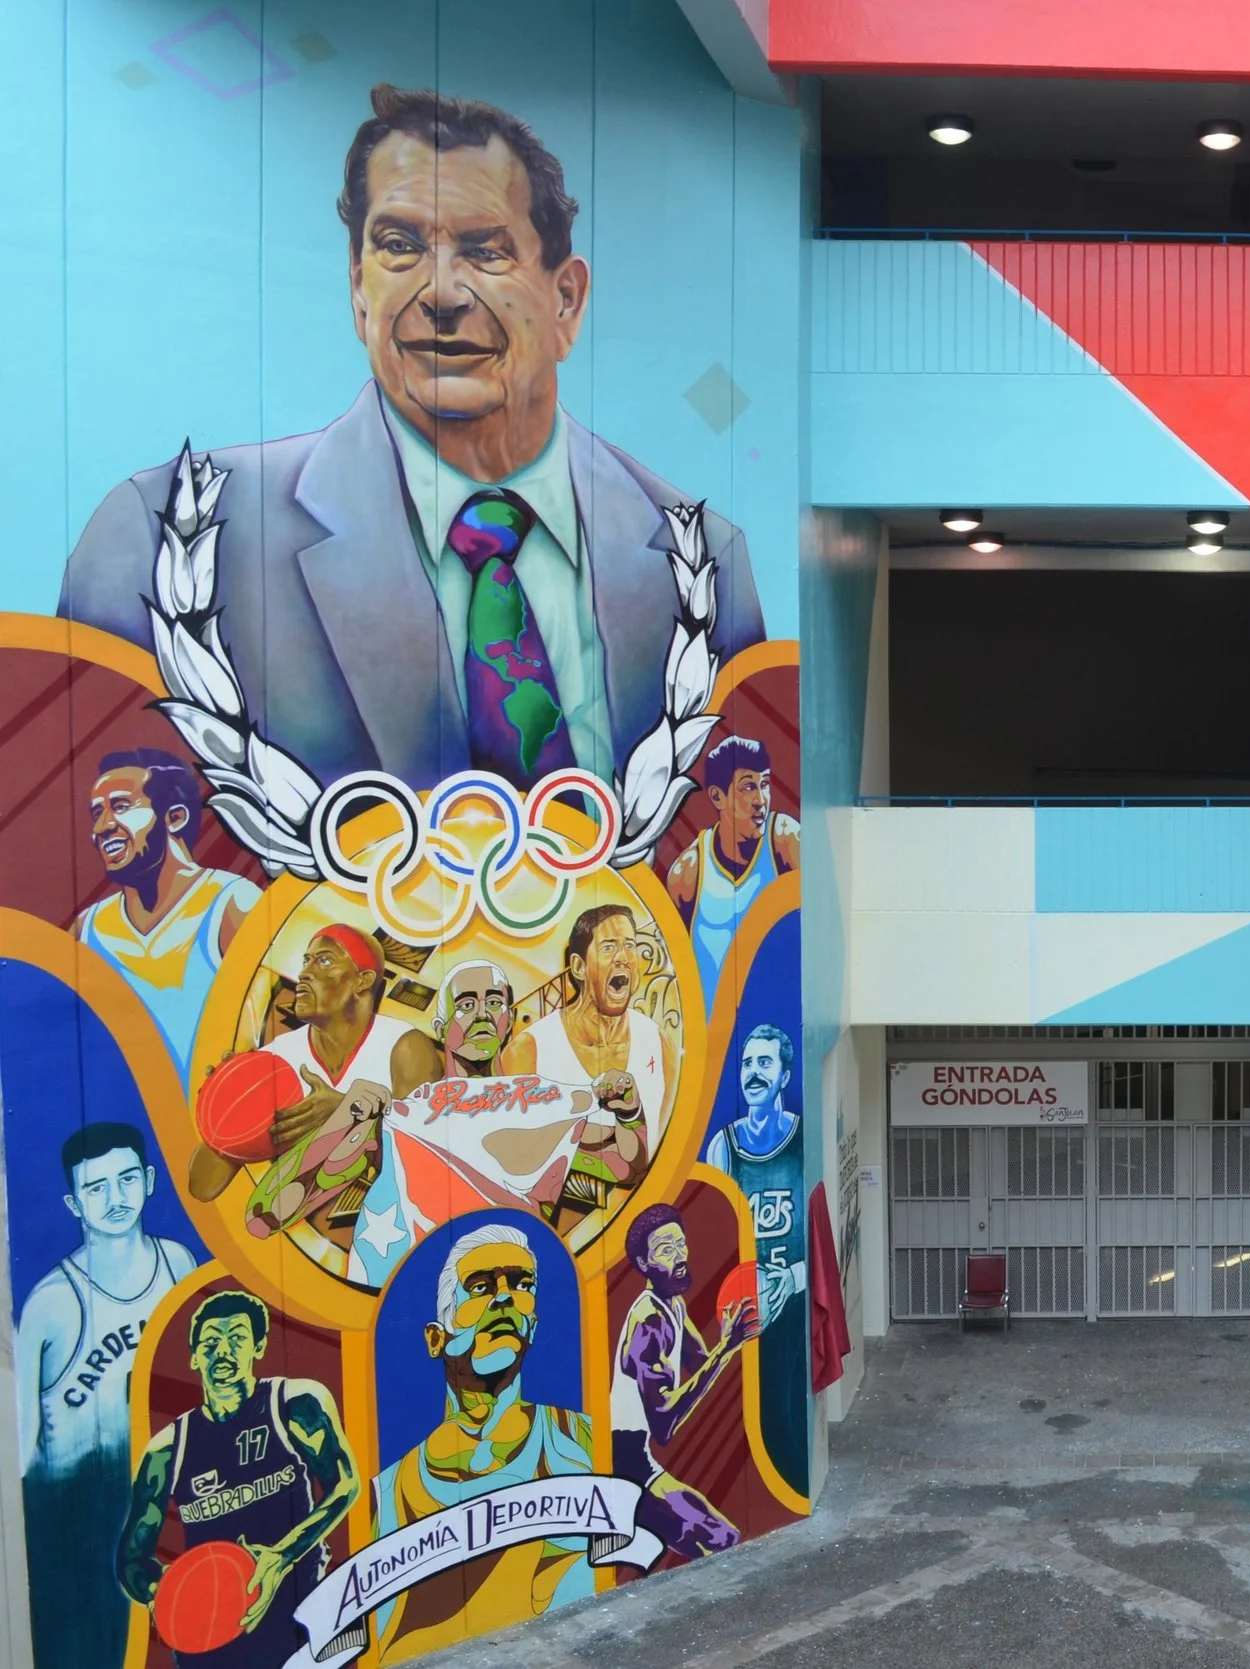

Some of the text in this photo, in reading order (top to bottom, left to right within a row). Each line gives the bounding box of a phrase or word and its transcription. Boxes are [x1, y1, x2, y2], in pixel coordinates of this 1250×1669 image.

[505, 1076, 563, 1115] Rico
[921, 1084, 1058, 1106] GÓNDOLAS
[933, 1066, 1046, 1083] ENTRADA
[63, 1319, 147, 1409] CARDE
[235, 1424, 270, 1466] 17
[178, 1464, 296, 1524] QUEBRADILLAS
[461, 1483, 618, 1552] DEPORTIVA
